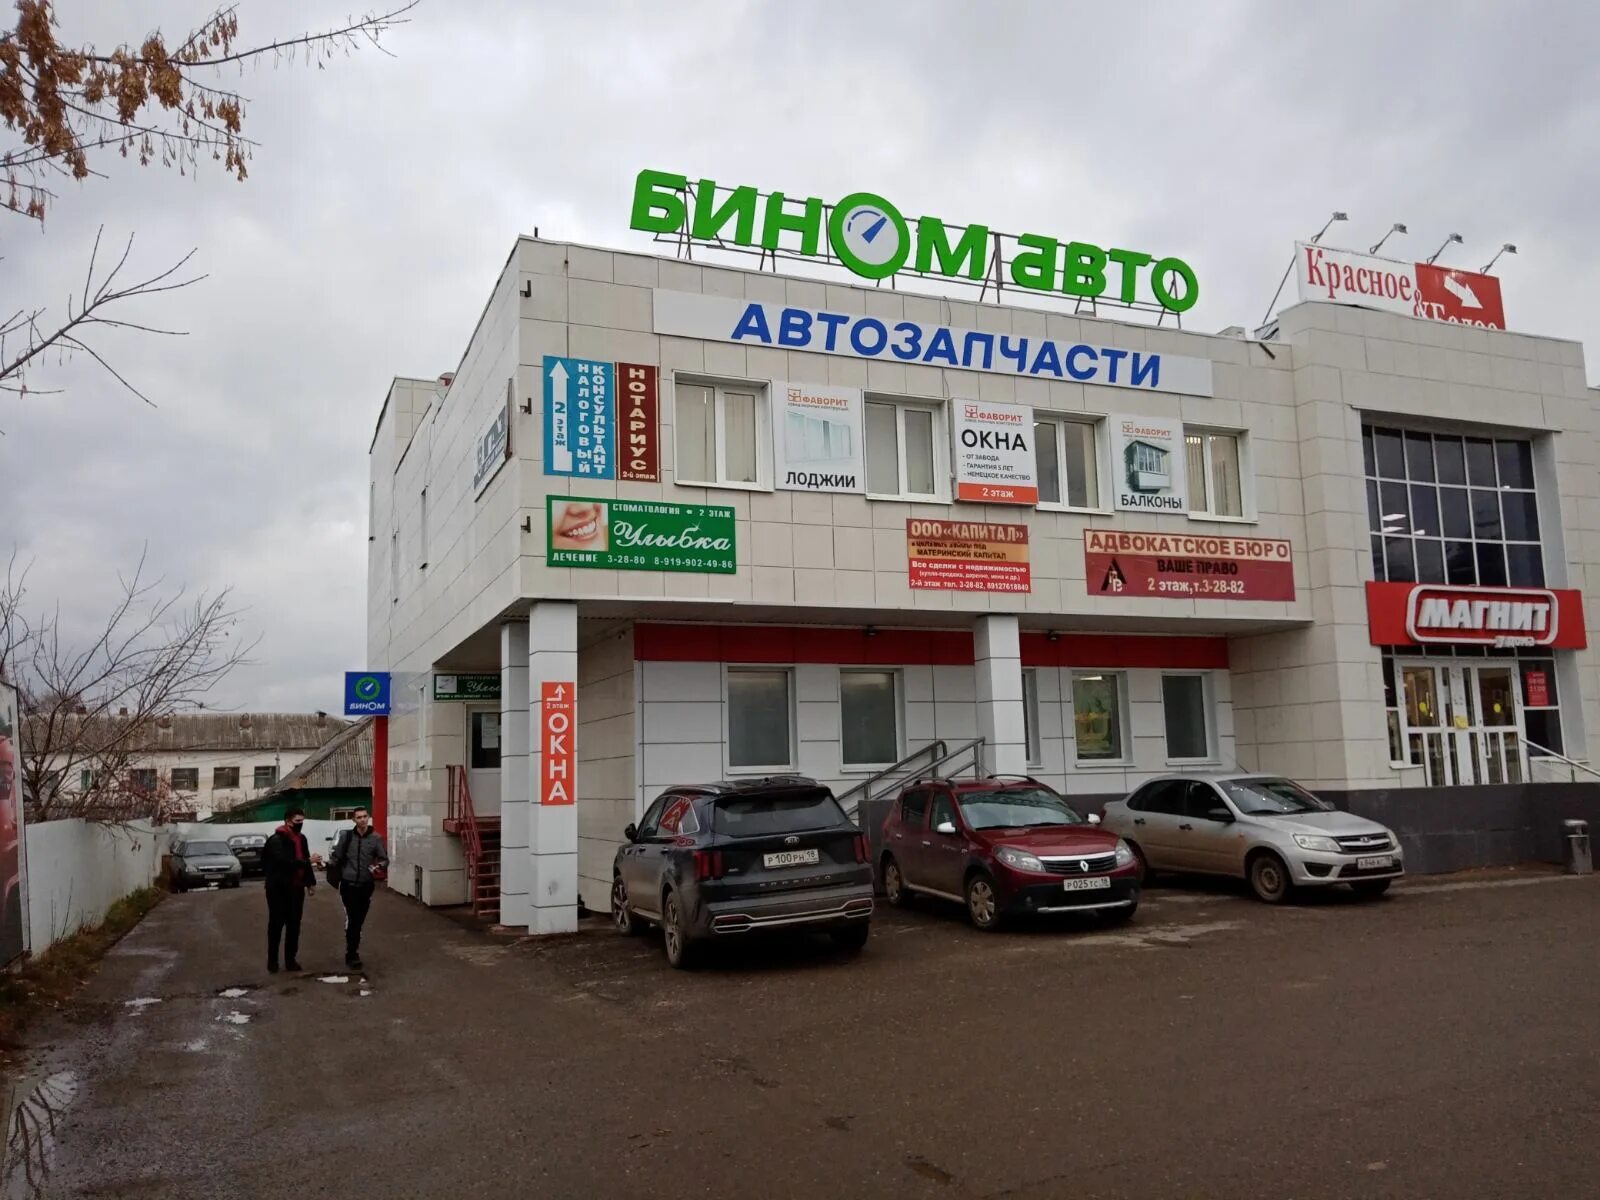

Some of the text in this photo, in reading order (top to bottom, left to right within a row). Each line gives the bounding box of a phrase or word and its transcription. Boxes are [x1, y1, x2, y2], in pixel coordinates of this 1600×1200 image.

[630, 169, 1199, 312] БИНОМ авто
[1304, 247, 1414, 301] Красное
[731, 303, 1160, 388] АВТОЗАПЧАСТИ
[554, 401, 566, 414] 2
[802, 396, 848, 407] ФАВОРИТ
[577, 363, 592, 473] НАЛОГОВЫЙ
[592, 365, 607, 475] КОНСУЛЬТАНТ
[628, 368, 647, 471] НОТАРИУС
[979, 412, 1023, 422] ФАВОРИТ
[1134, 427, 1172, 437] ФАВОРИТ
[961, 428, 1028, 452] ОКНА
[975, 454, 1000, 462] ЗАВОДА
[966, 462, 997, 471] ГАРАНТИЯ
[635, 472, 656, 480] этаж
[785, 471, 856, 489] ЛОДЖИИ
[1000, 473, 1031, 481] КАЧЕСТВО
[982, 487, 1014, 498] 2 этаж
[1121, 494, 1182, 509] БАЛКОНЫ
[612, 503, 731, 518] СТОМАТОЛОГИЯ 2 ЭТАЖ
[613, 520, 732, 551] Улыбка
[911, 521, 942, 537] ООО
[1090, 533, 1288, 558] АДВОКАТСКОЕ БЮРО
[552, 552, 733, 569] ЛЕЧЕНИЕ 3-28-80 8-919-902-49-86
[917, 549, 1007, 560] МАТЕРИНСКИЙ КАПИТАЛ
[912, 560, 927, 568] Все
[929, 562, 957, 570] сделки
[965, 564, 1027, 573] недвижимостью
[1157, 559, 1238, 576] ВАШЕ ПРАВО
[1147, 577, 1155, 591] 2
[1417, 598, 1550, 631] МАГНИТ
[349, 701, 386, 711] БИНОМ
[548, 712, 569, 801] ОКНА
